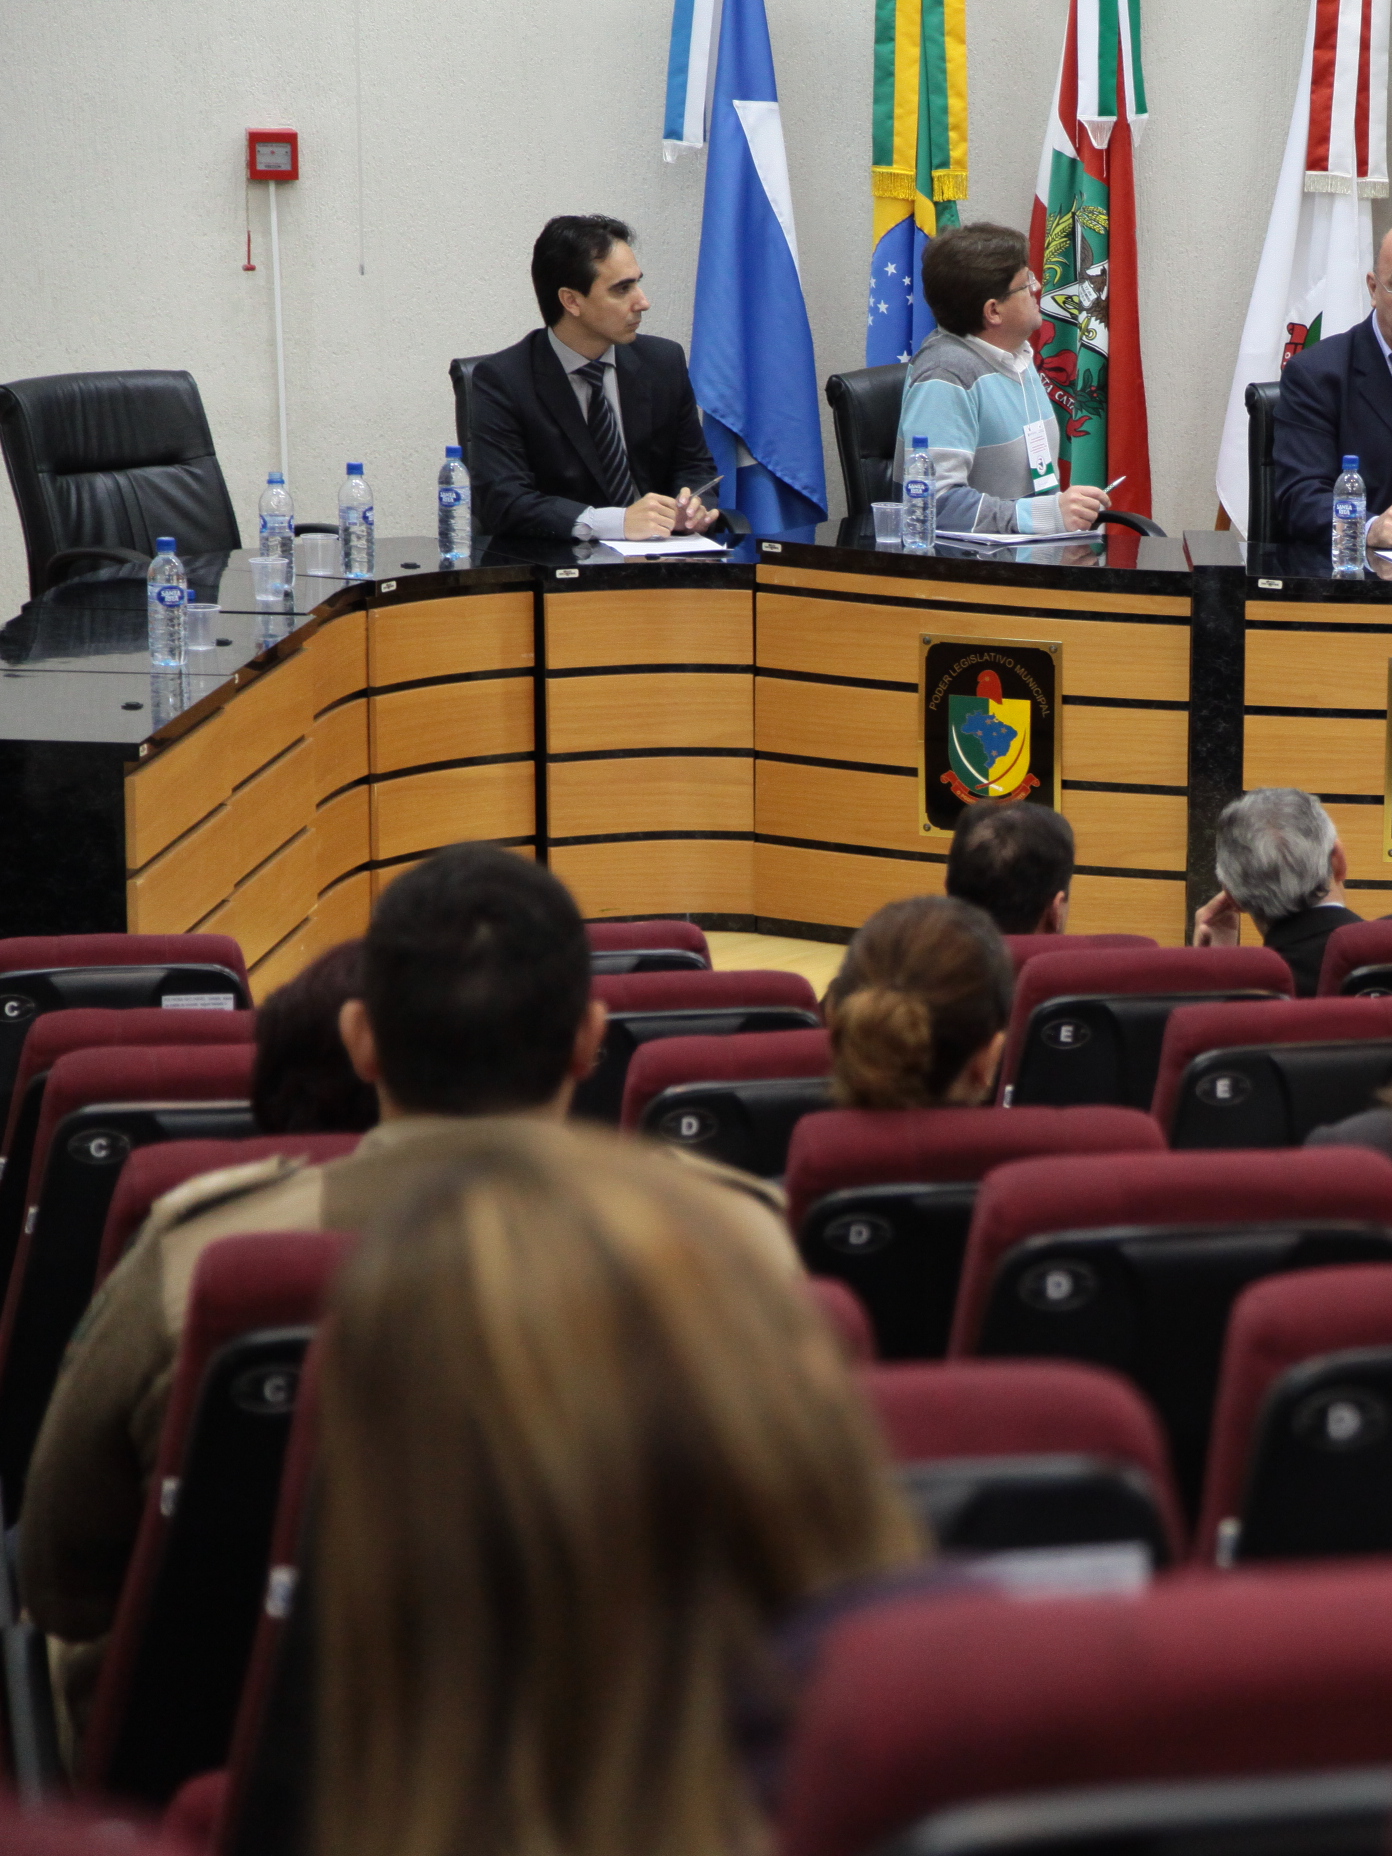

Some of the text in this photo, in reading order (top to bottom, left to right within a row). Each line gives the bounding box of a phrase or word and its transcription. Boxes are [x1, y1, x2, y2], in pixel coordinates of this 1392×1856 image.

[929, 653, 1050, 718] PODER LEGISLATIVO MUNICIPAL
[5, 1001, 19, 1017] C
[1060, 1025, 1073, 1042] E
[1216, 1079, 1231, 1099] E
[681, 1116, 699, 1136] D
[90, 1138, 107, 1157] C
[849, 1224, 869, 1245] D
[1046, 1271, 1072, 1299] D
